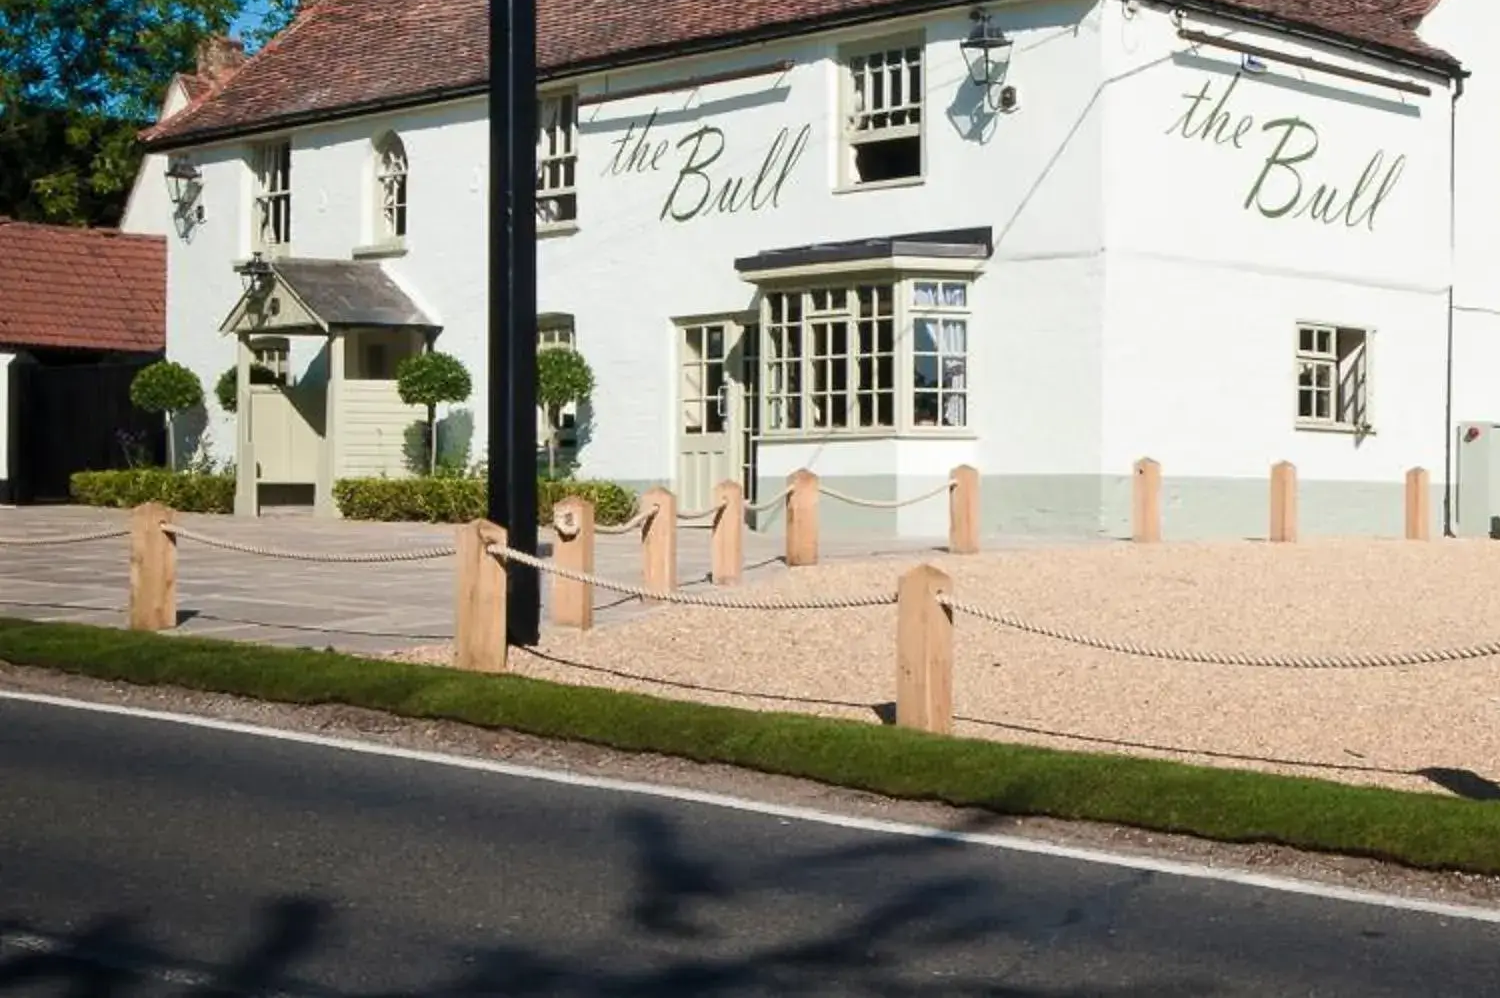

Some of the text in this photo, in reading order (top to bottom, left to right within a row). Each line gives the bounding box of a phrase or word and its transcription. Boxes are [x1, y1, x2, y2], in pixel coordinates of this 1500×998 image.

[602, 107, 811, 221] the Bull
[1165, 72, 1405, 231] the Bull
